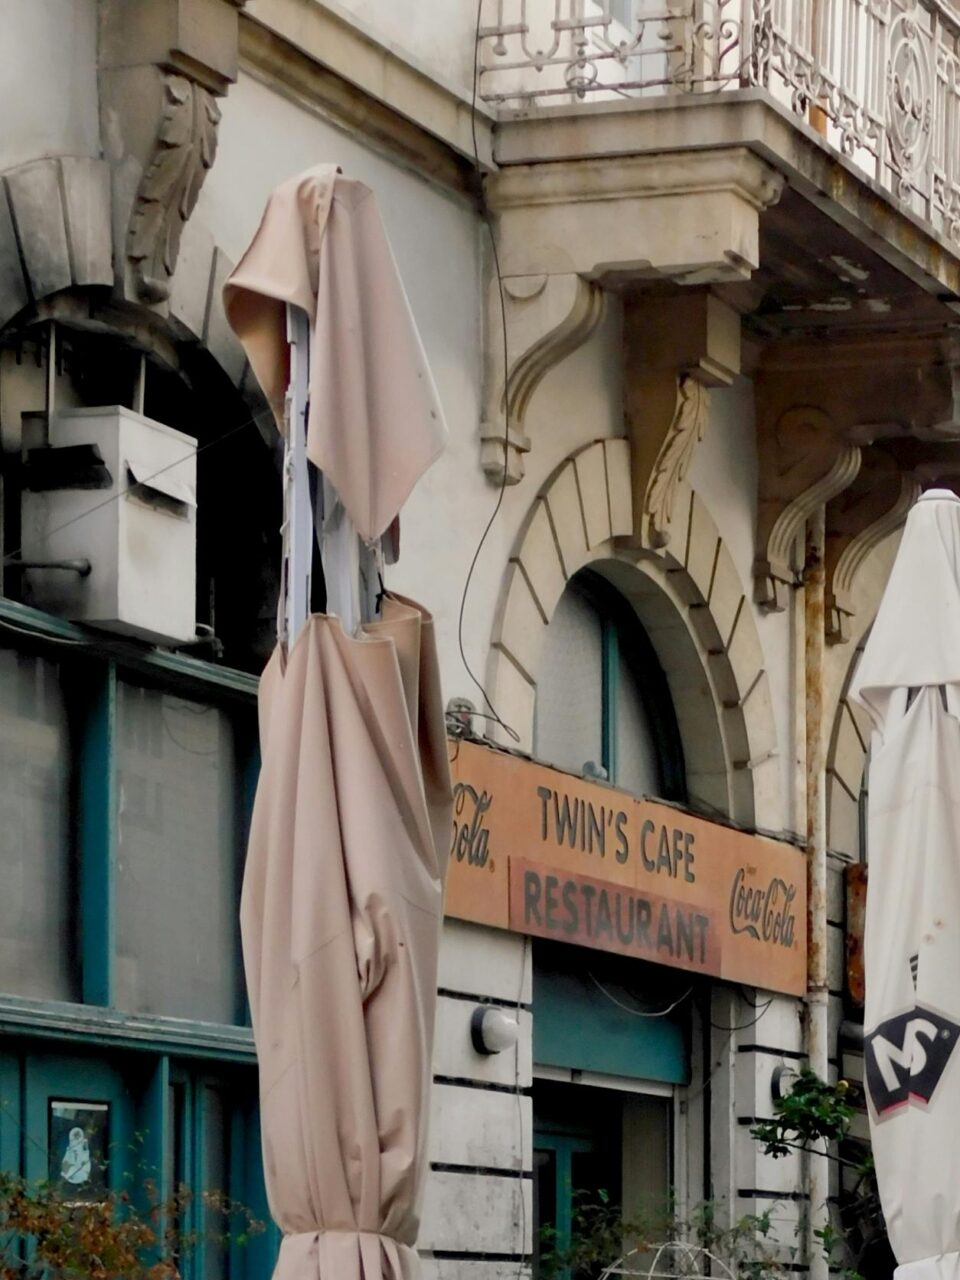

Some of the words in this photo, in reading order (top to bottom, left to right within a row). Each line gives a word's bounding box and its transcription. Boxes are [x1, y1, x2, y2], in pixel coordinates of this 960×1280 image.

[536, 785, 630, 865] TWIN'S
[639, 818, 696, 883] CAFE
[523, 870, 710, 965] RESTAURANT
